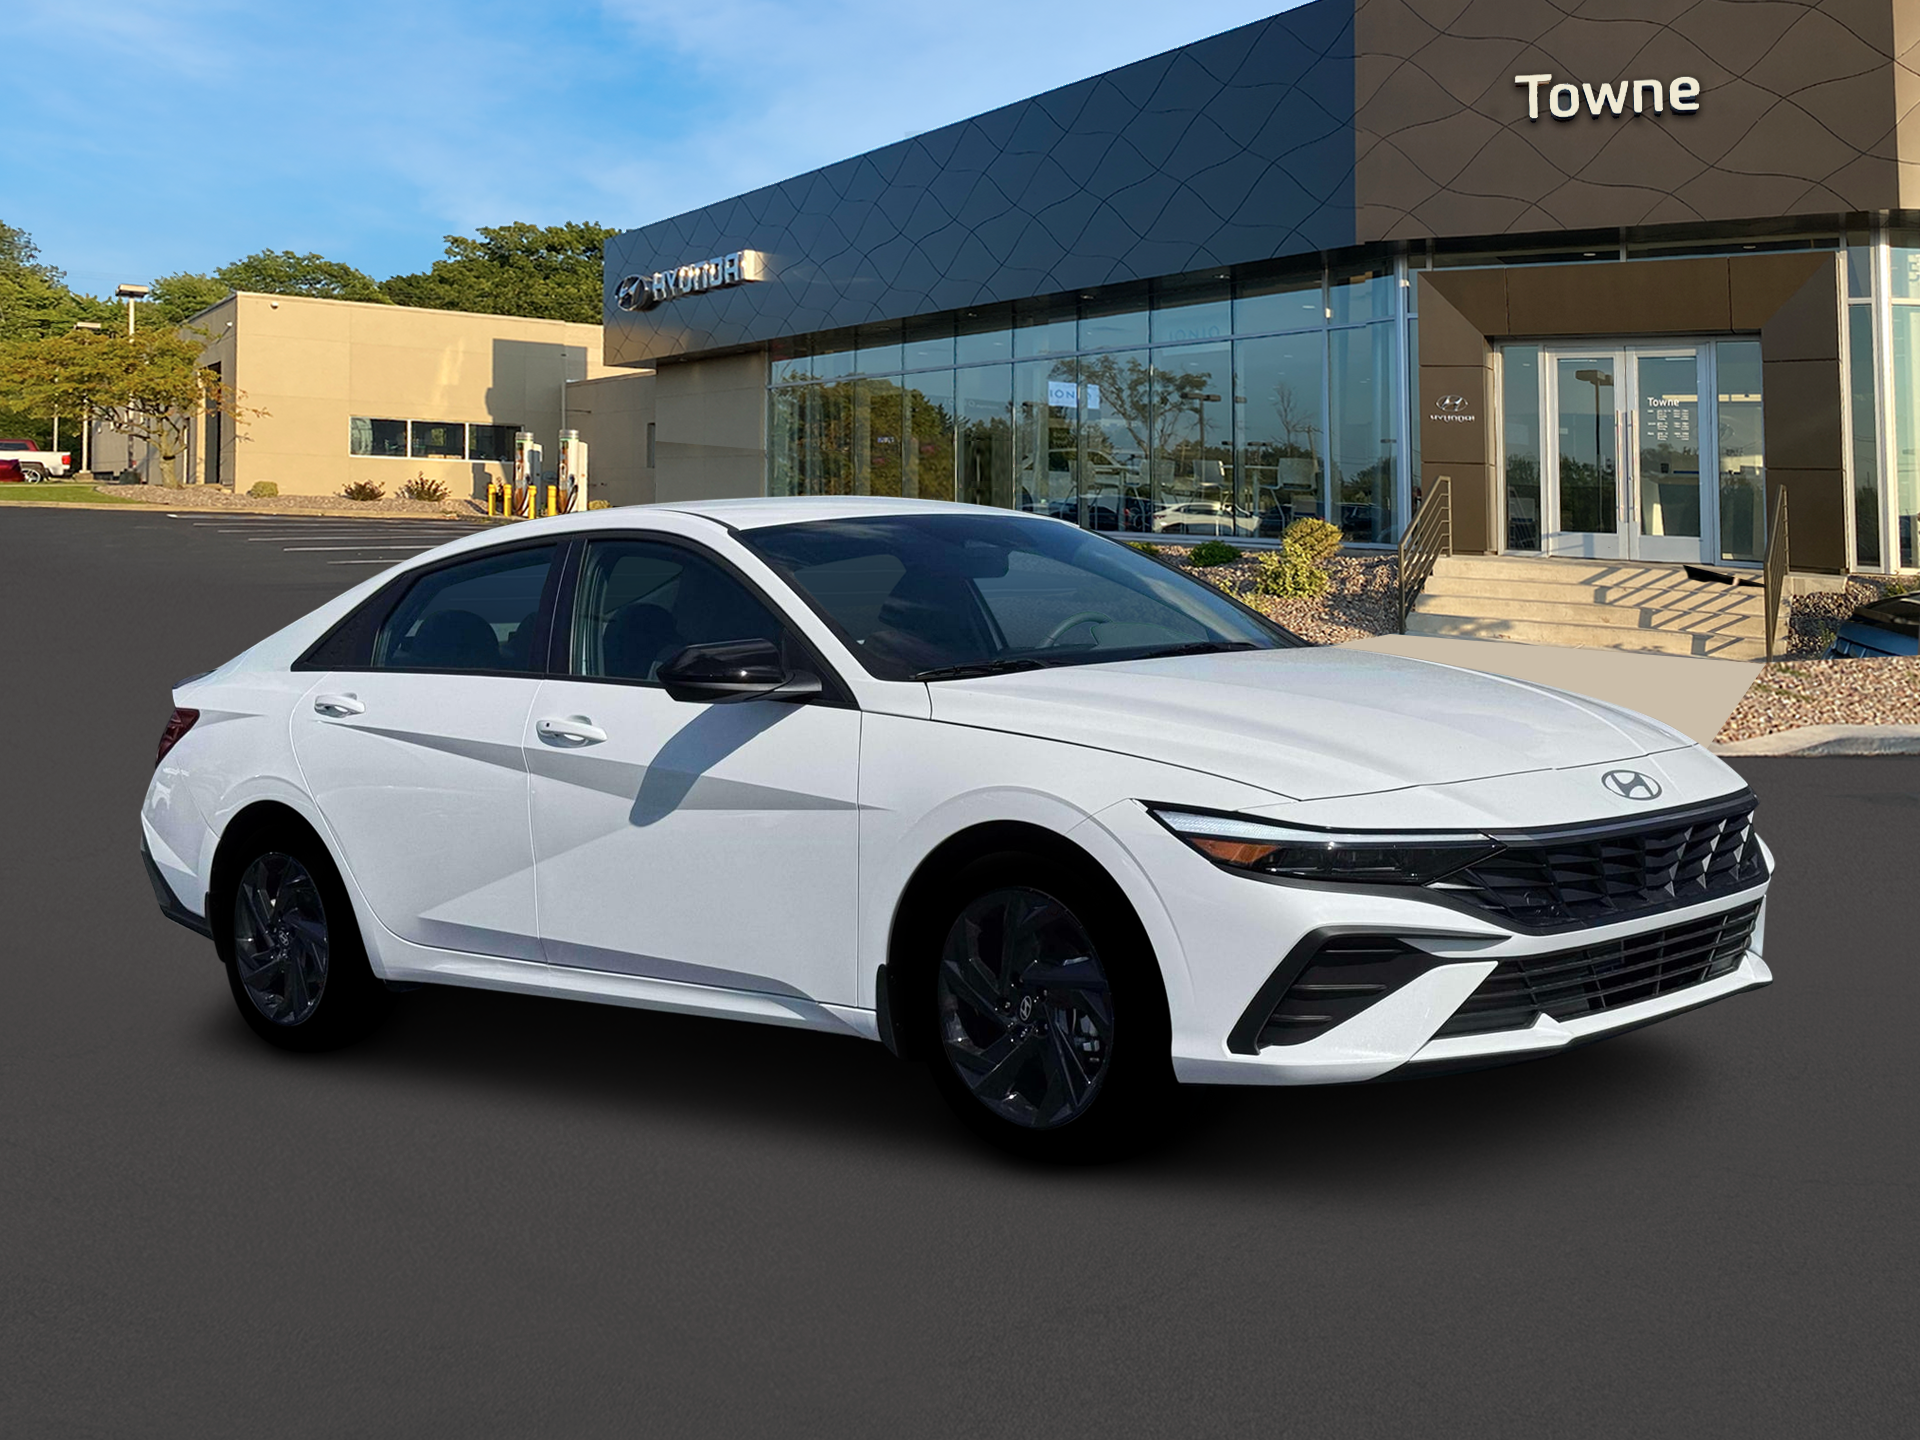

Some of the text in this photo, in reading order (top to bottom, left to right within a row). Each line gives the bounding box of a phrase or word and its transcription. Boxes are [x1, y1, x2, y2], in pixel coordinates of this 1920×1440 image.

[1514, 73, 1701, 123] Towne
[1647, 396, 1680, 407] Towne
[1430, 414, 1475, 423] HYUNDAI
